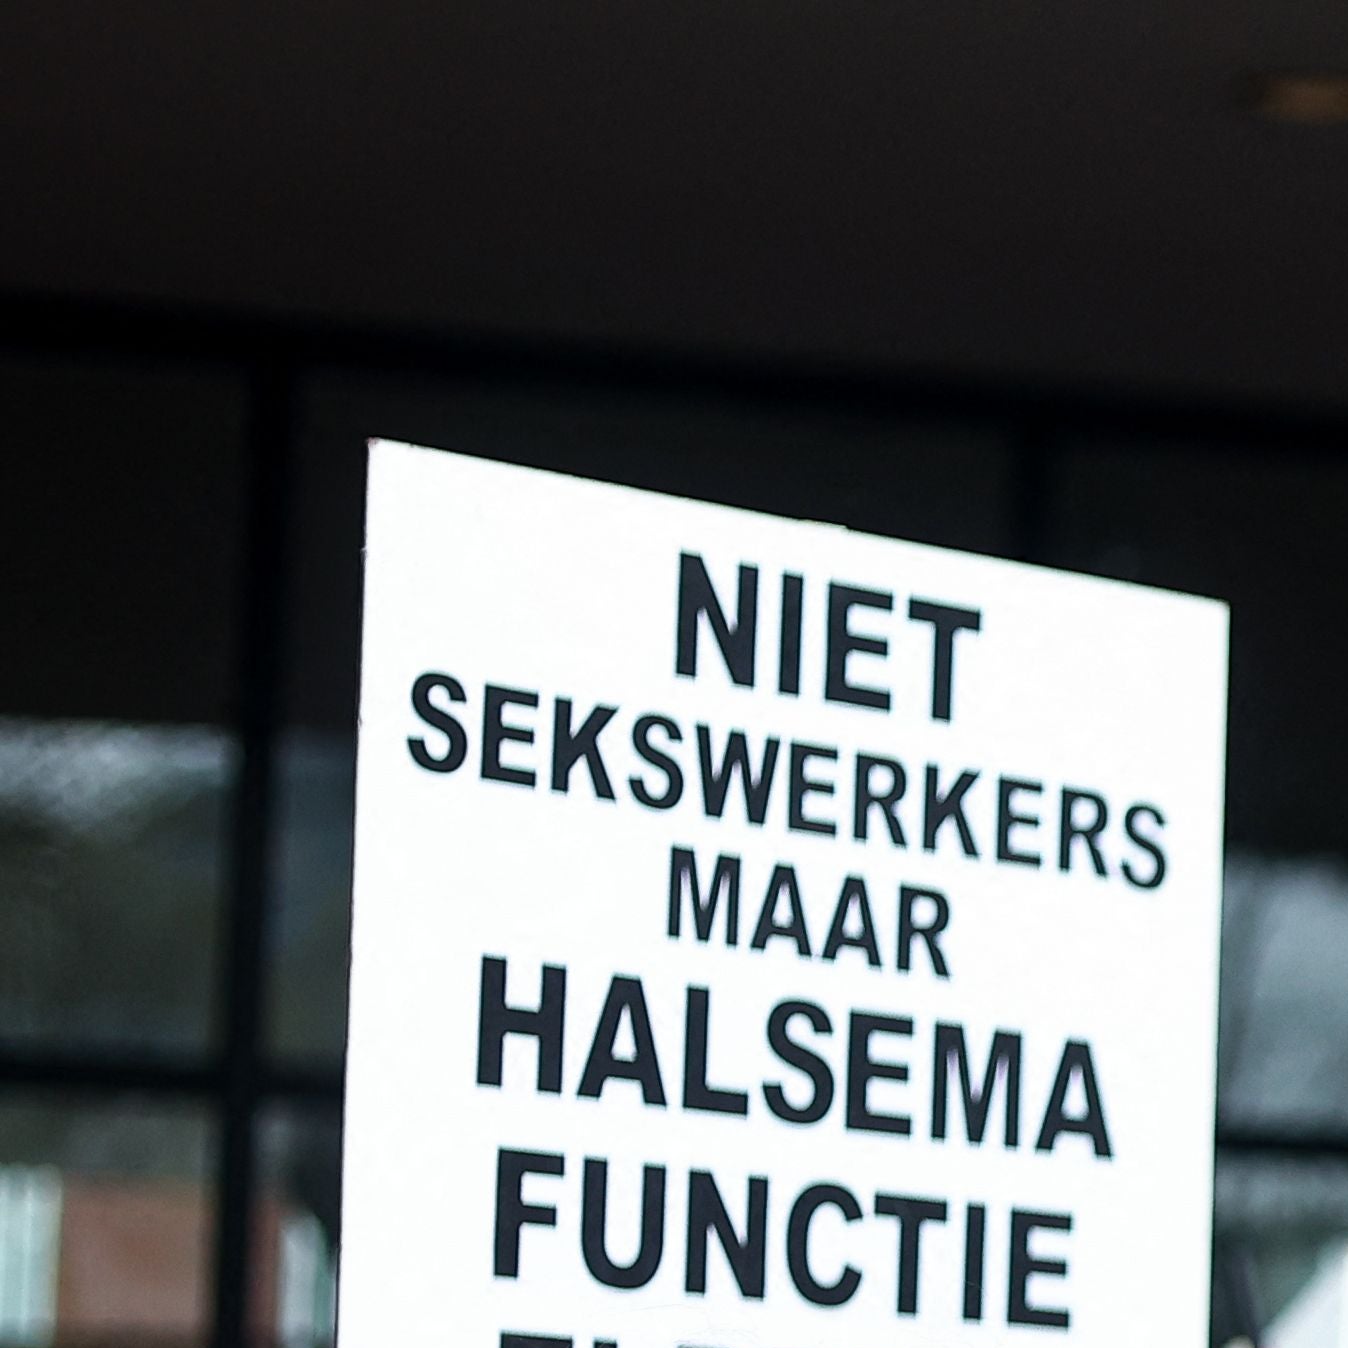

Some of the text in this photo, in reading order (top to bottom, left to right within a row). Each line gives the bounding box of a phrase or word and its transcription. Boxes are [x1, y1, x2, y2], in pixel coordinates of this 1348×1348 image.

[674, 551, 982, 723] NIET
[405, 671, 1168, 890] SEKSWERKERS
[667, 845, 951, 979] MAAR
[475, 954, 1113, 1160] HALSEMA
[492, 1147, 1073, 1331] FUNCTIE
